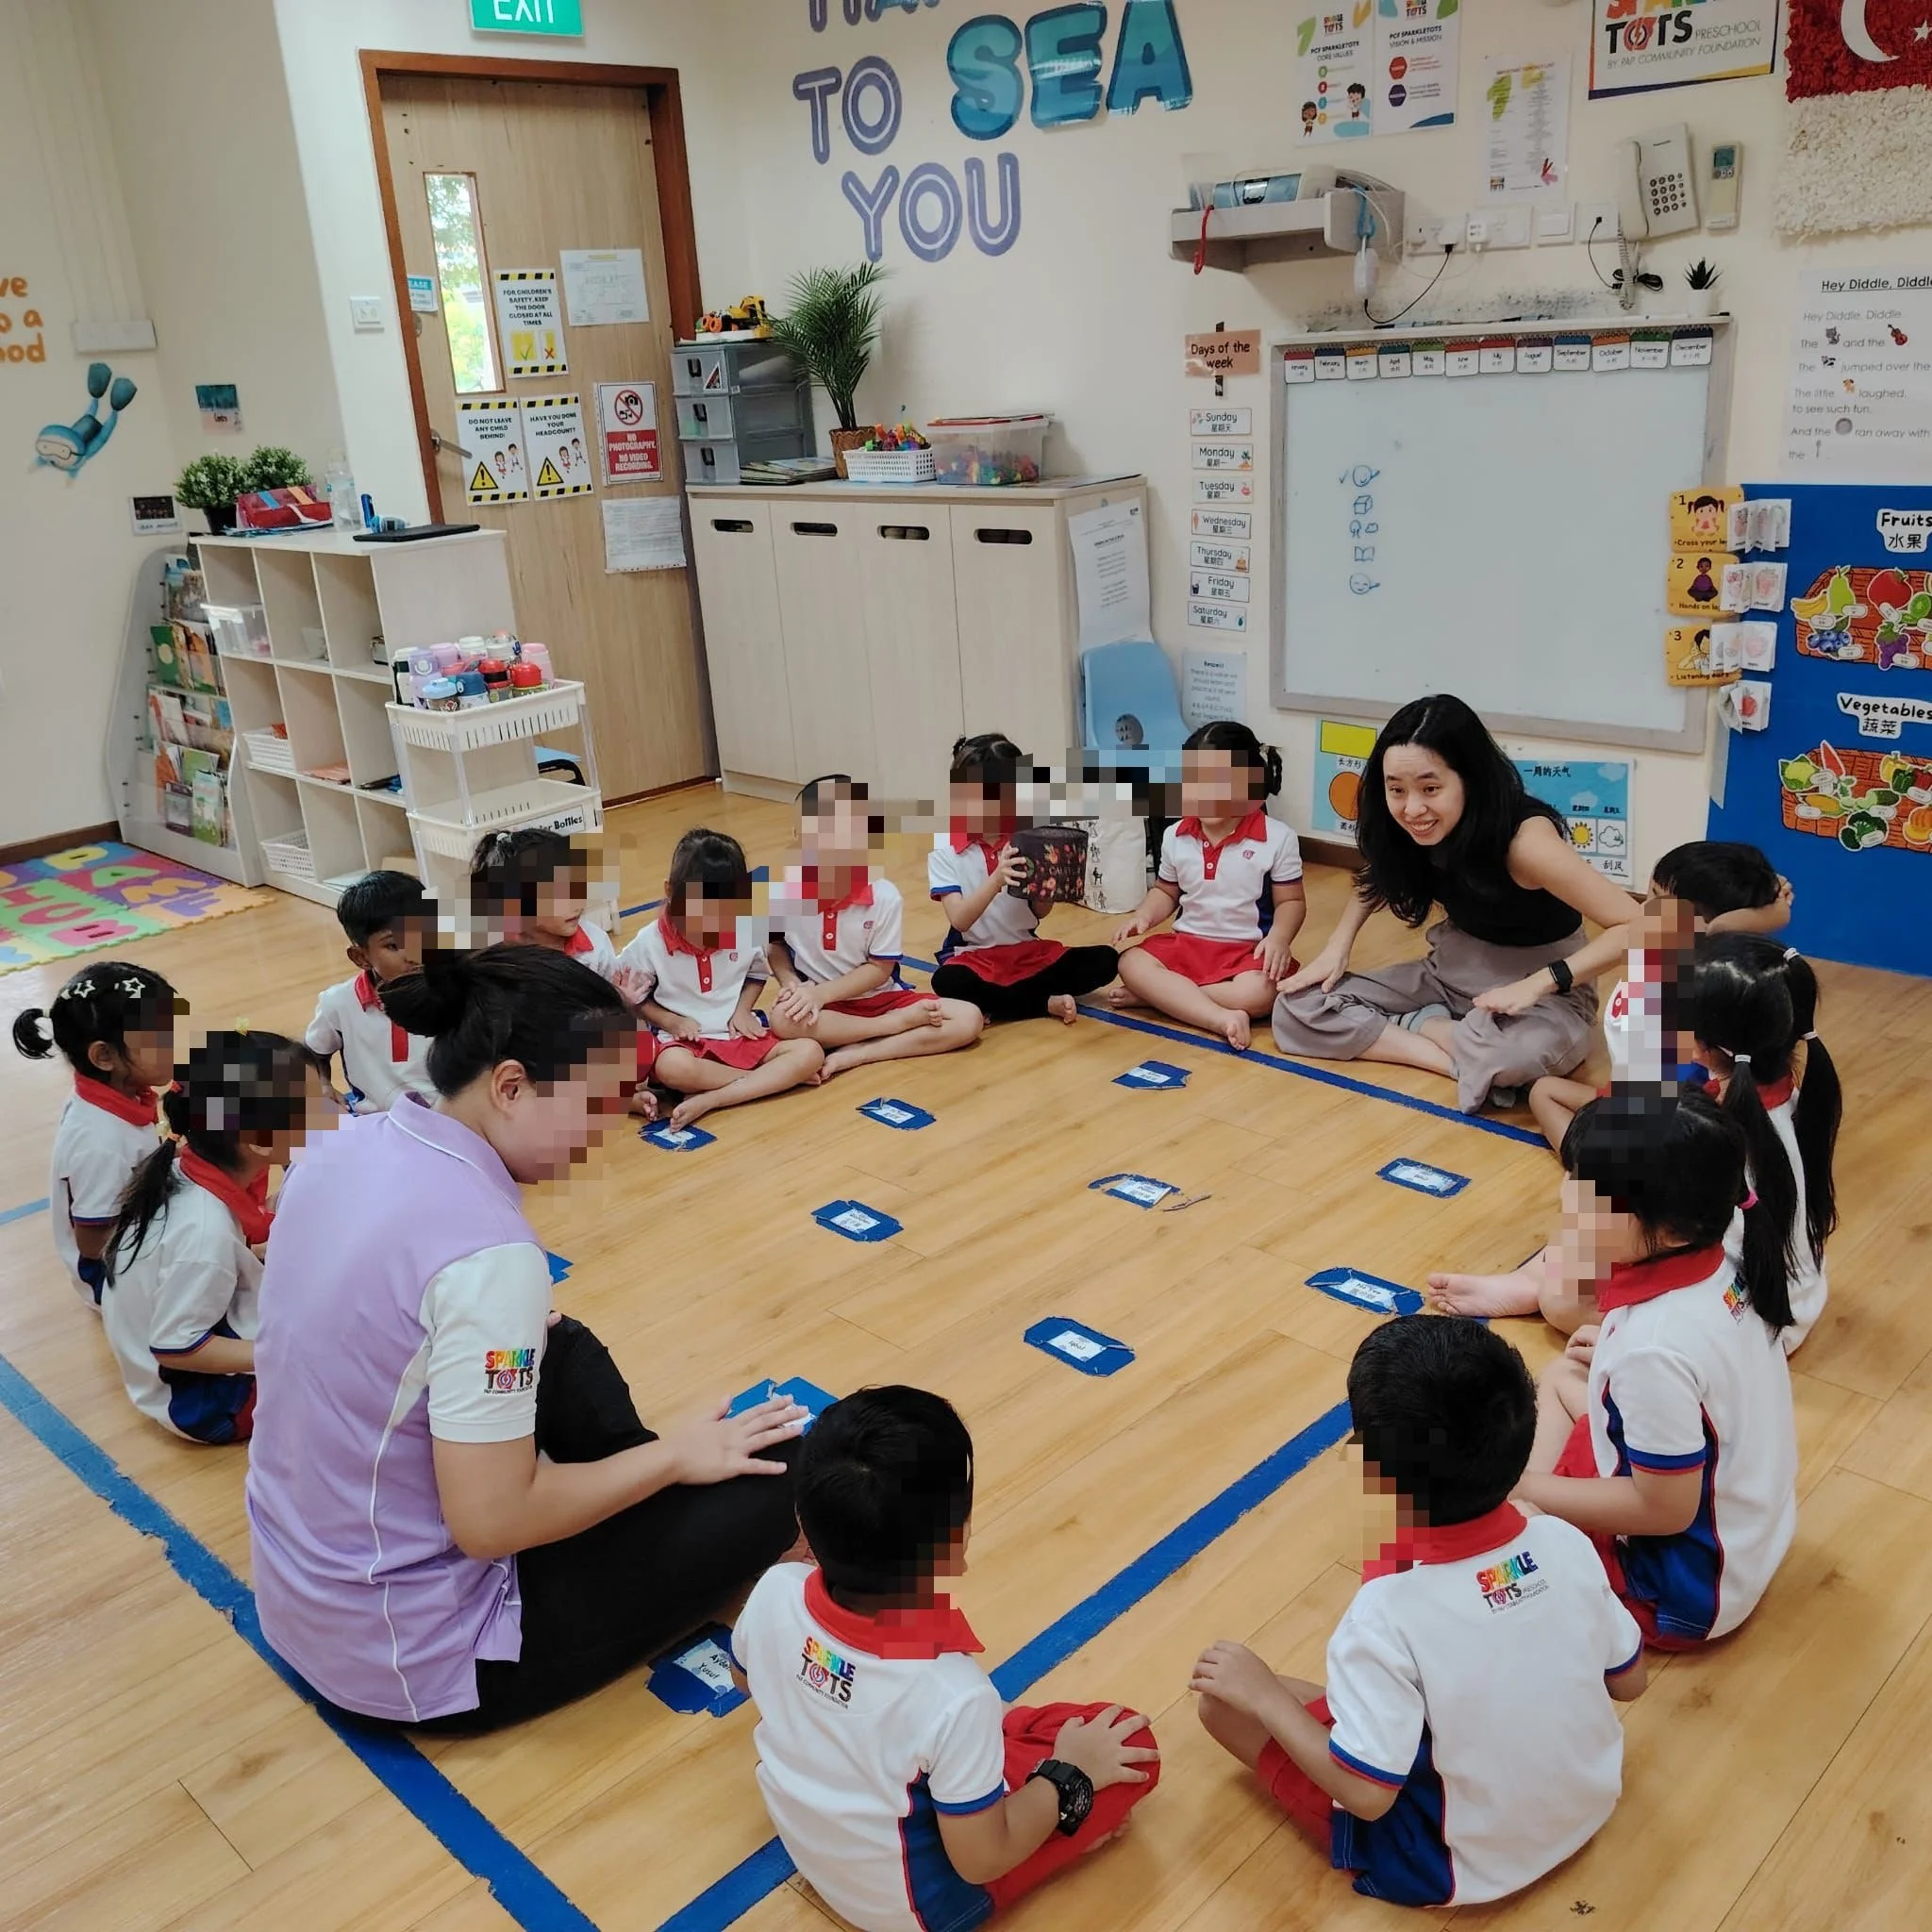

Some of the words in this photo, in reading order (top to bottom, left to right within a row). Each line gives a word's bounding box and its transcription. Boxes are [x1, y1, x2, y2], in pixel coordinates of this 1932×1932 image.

[1401, 25, 1441, 37] SPARKLETOTS
[1605, 9, 1693, 54] TOTS
[1694, 19, 1761, 41] PRESCHOOL
[1321, 41, 1359, 53] SPARKLETOTS
[1607, 59, 1618, 70] BY
[1620, 56, 1636, 66] PAP
[1638, 47, 1696, 64] COMMUNITY
[1697, 37, 1761, 55] FOUNDATION
[793, 56, 902, 165] TO
[947, 0, 1193, 141] SEA
[841, 152, 1022, 263] YOU
[1822, 280, 1844, 291] Hey
[1849, 278, 1892, 290] Diddle,
[1897, 275, 1932, 288] Diddl
[24, 309, 43, 328] a
[1803, 311, 1823, 322] Hey
[1866, 309, 1902, 320] Diddle
[1191, 343, 1215, 358] Days
[1218, 341, 1229, 354] of
[1233, 341, 1251, 353] the
[1801, 340, 1819, 348] The
[1842, 339, 1865, 348] and
[1868, 338, 1885, 347] the
[1599, 348, 1624, 357] October
[1206, 357, 1234, 369] week
[1798, 362, 1816, 372] The
[1840, 362, 1882, 374] jumped
[1886, 363, 1910, 372] over
[1913, 361, 1931, 371] the
[1794, 389, 1812, 398] The
[1814, 388, 1835, 397] little
[1792, 405, 1803, 414] to
[1826, 405, 1850, 414] such
[1206, 412, 1238, 424] Sunday
[626, 432, 637, 441] NO
[1790, 427, 1811, 436] And
[1815, 427, 1831, 436] the
[1875, 428, 1907, 439] away
[1907, 427, 1930, 437] with
[618, 454, 628, 463] NO
[629, 453, 649, 462] VIDEO
[1199, 447, 1235, 458] Monday
[1789, 451, 1806, 459] the
[1199, 481, 1235, 492] Tuesday
[1678, 494, 1687, 506] 1
[1202, 515, 1246, 528] Wednesday
[1881, 512, 1932, 527] Fruits
[1888, 533, 1922, 549] 水果
[1196, 545, 1232, 559] Thursday
[1675, 558, 1684, 570] 2
[1208, 575, 1235, 590] Friday
[1192, 605, 1227, 618] Saturday
[1674, 630, 1682, 641] 3
[1675, 673, 1709, 681] Listening
[1840, 696, 1932, 720] Vegetables
[1862, 717, 1897, 736] 蔬菜
[554, 816, 582, 829] Bottles
[485, 1348, 536, 1369] SPARKLE
[485, 1366, 534, 1389] TOTS
[1476, 1551, 1539, 1592] SPARKLE
[1483, 1582, 1522, 1608] TOTS
[804, 1636, 857, 1682] SPARKLE
[801, 1653, 852, 1702] TOTS
